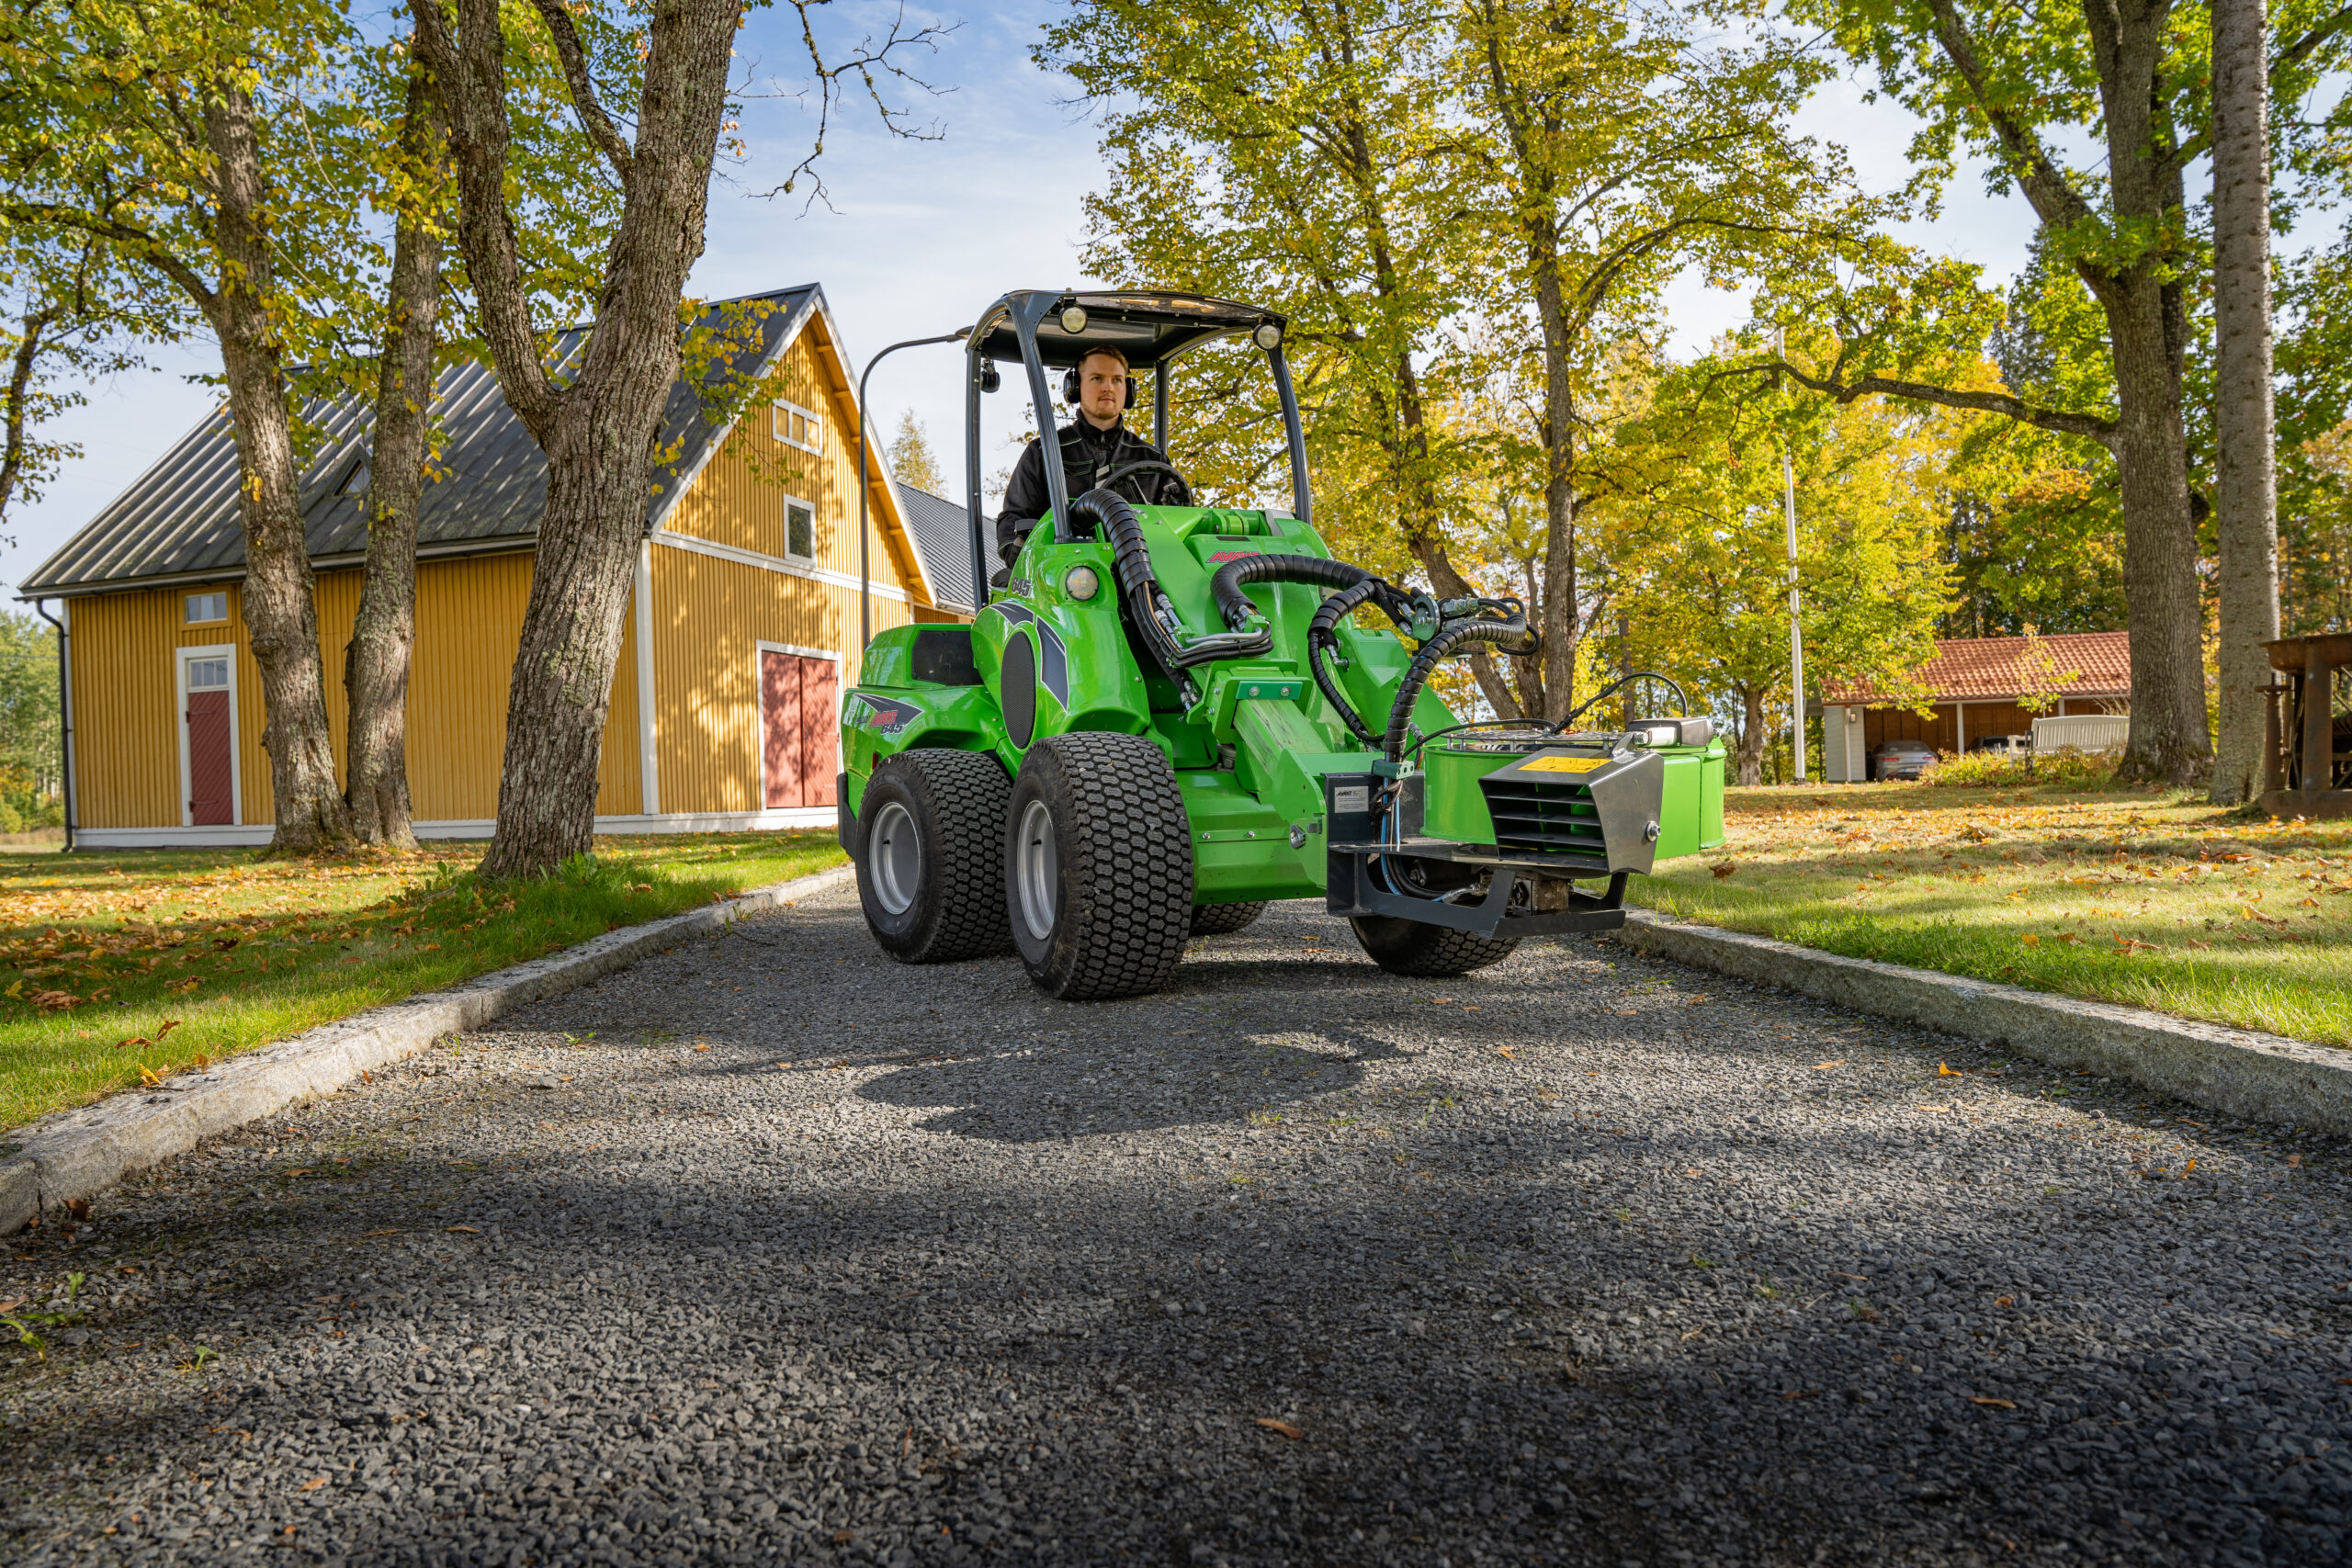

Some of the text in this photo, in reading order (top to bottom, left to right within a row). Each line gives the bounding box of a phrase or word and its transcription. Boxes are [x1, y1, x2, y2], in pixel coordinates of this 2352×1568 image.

[1012, 576, 1032, 597] 645
[868, 710, 899, 728] AVANT
[880, 722, 905, 735] 645
